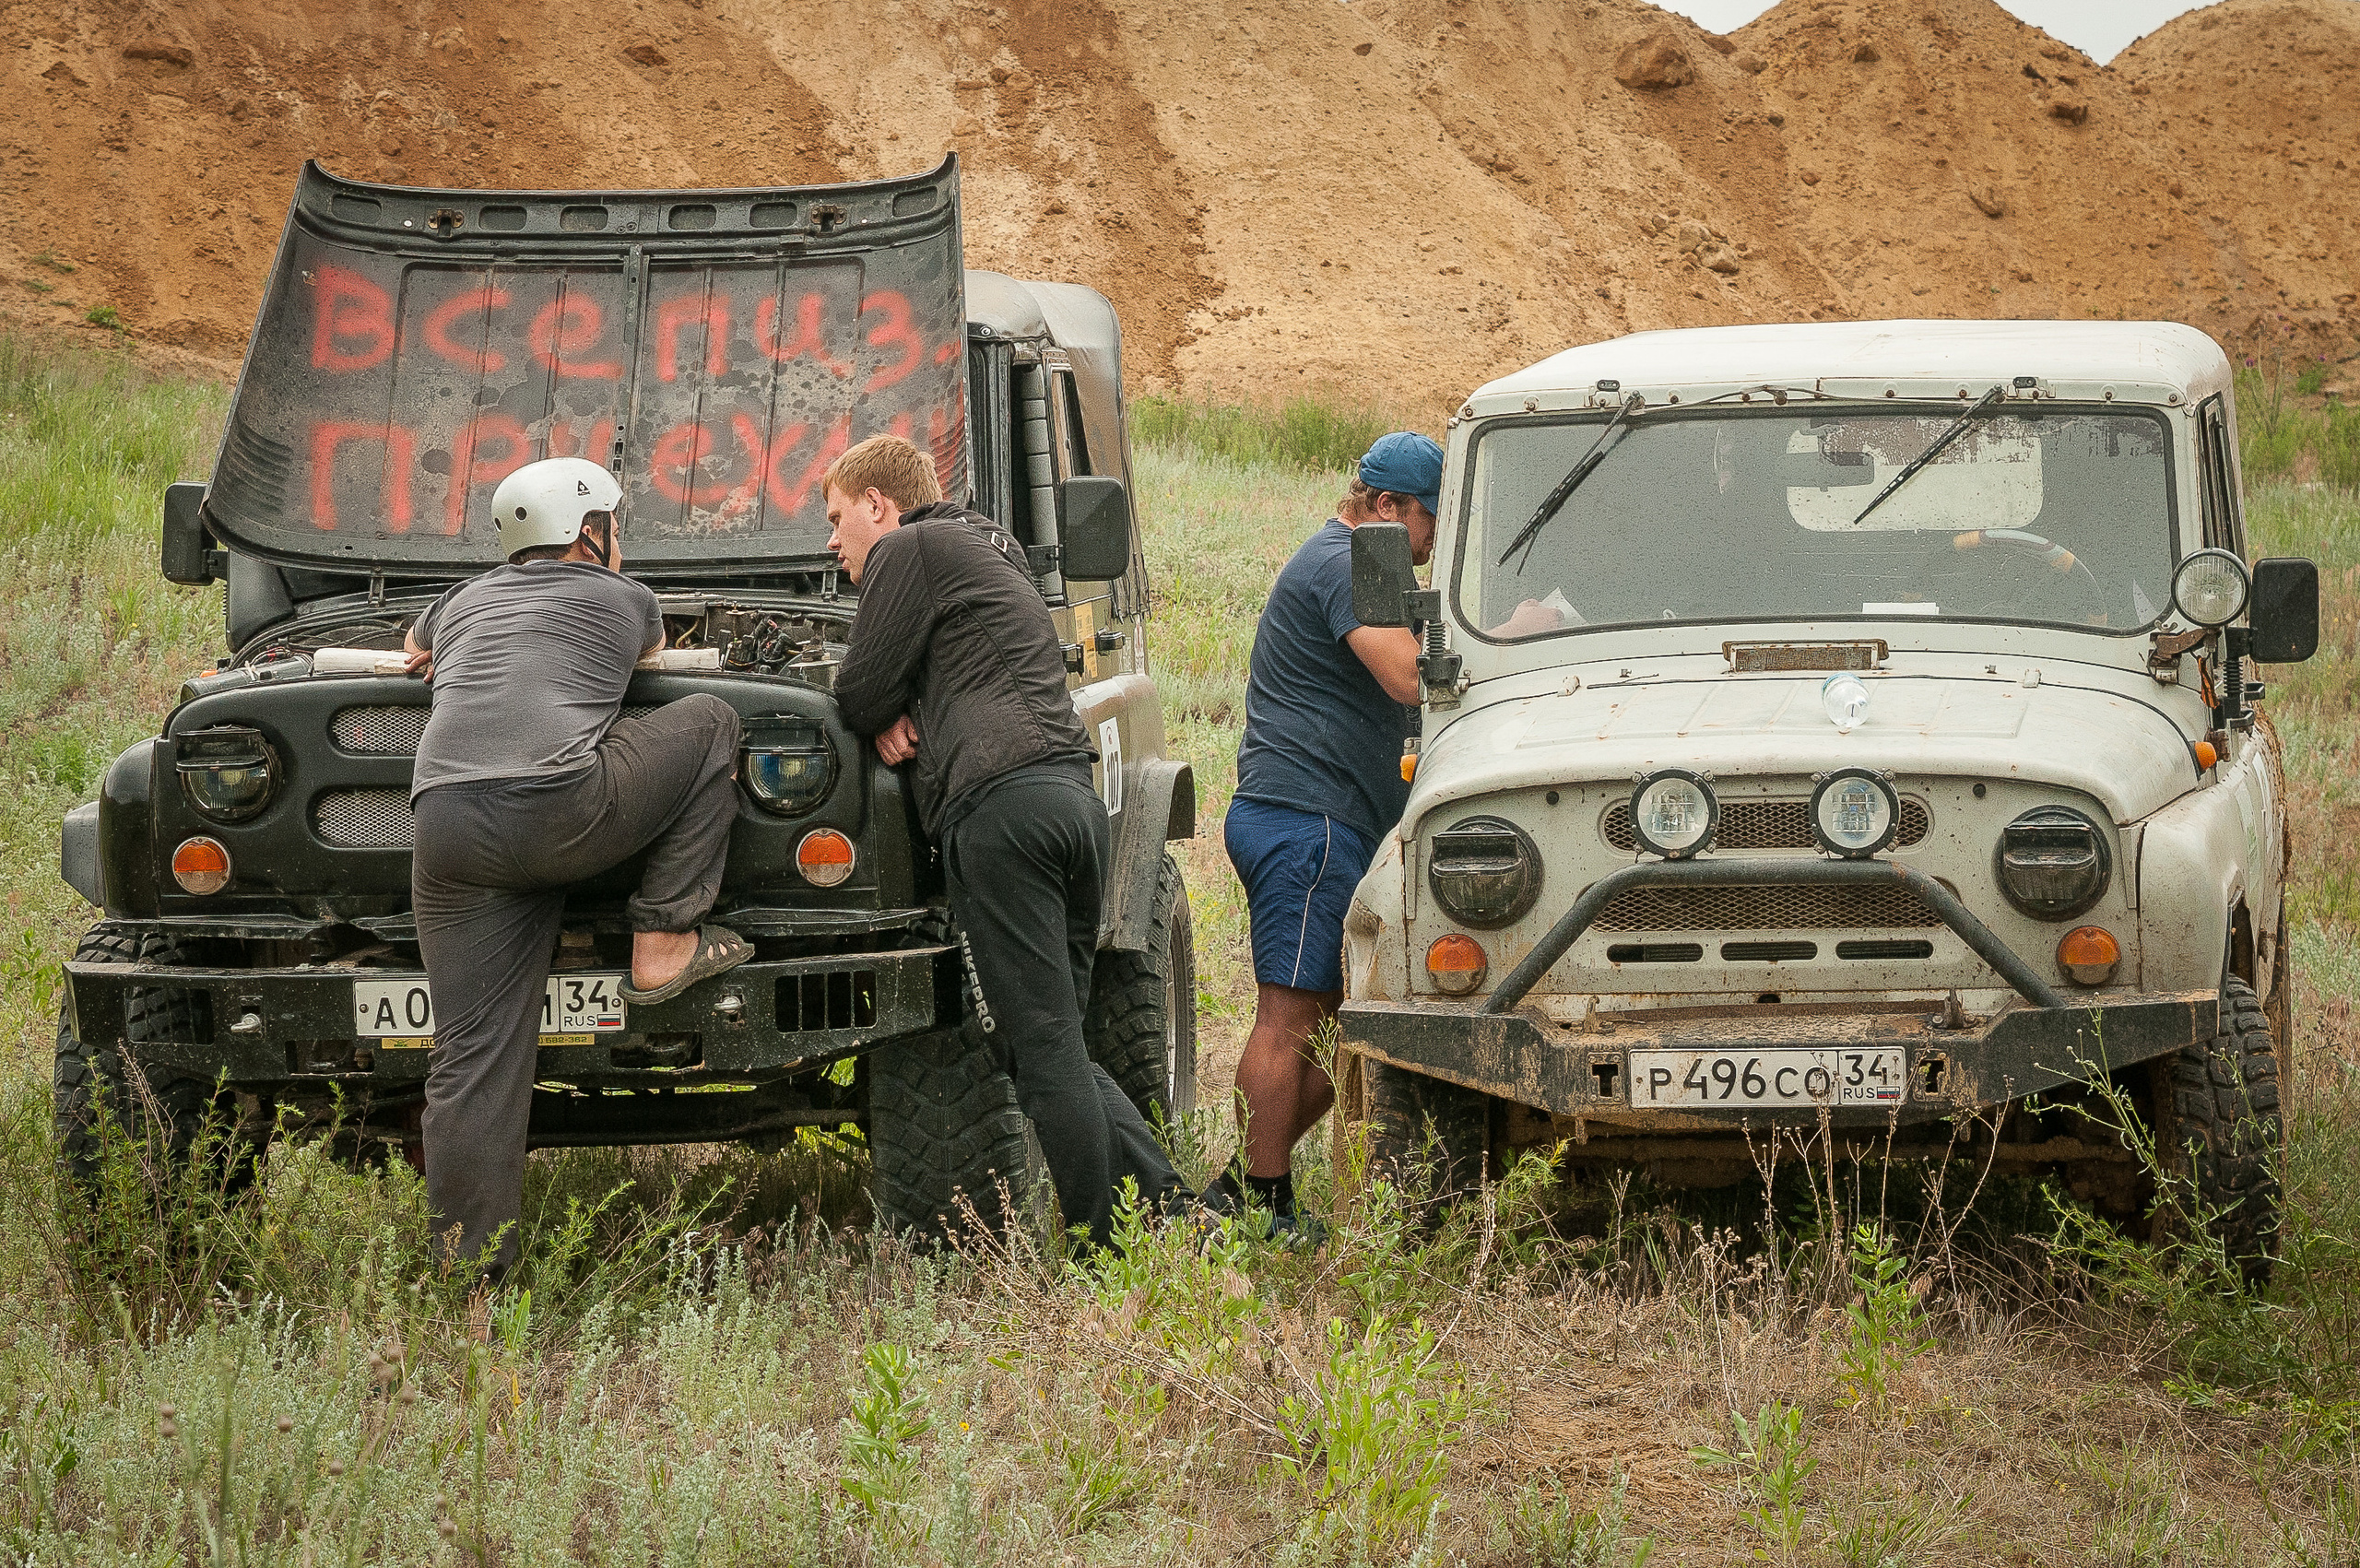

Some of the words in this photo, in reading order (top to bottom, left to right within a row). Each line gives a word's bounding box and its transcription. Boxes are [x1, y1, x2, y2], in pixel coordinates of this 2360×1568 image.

[565, 980, 608, 1012] 34
[563, 1015, 596, 1027] RUS
[1649, 1057, 1831, 1100] Р496СО
[1845, 1054, 1888, 1086] 34
[1843, 1087, 1875, 1100] RUS
